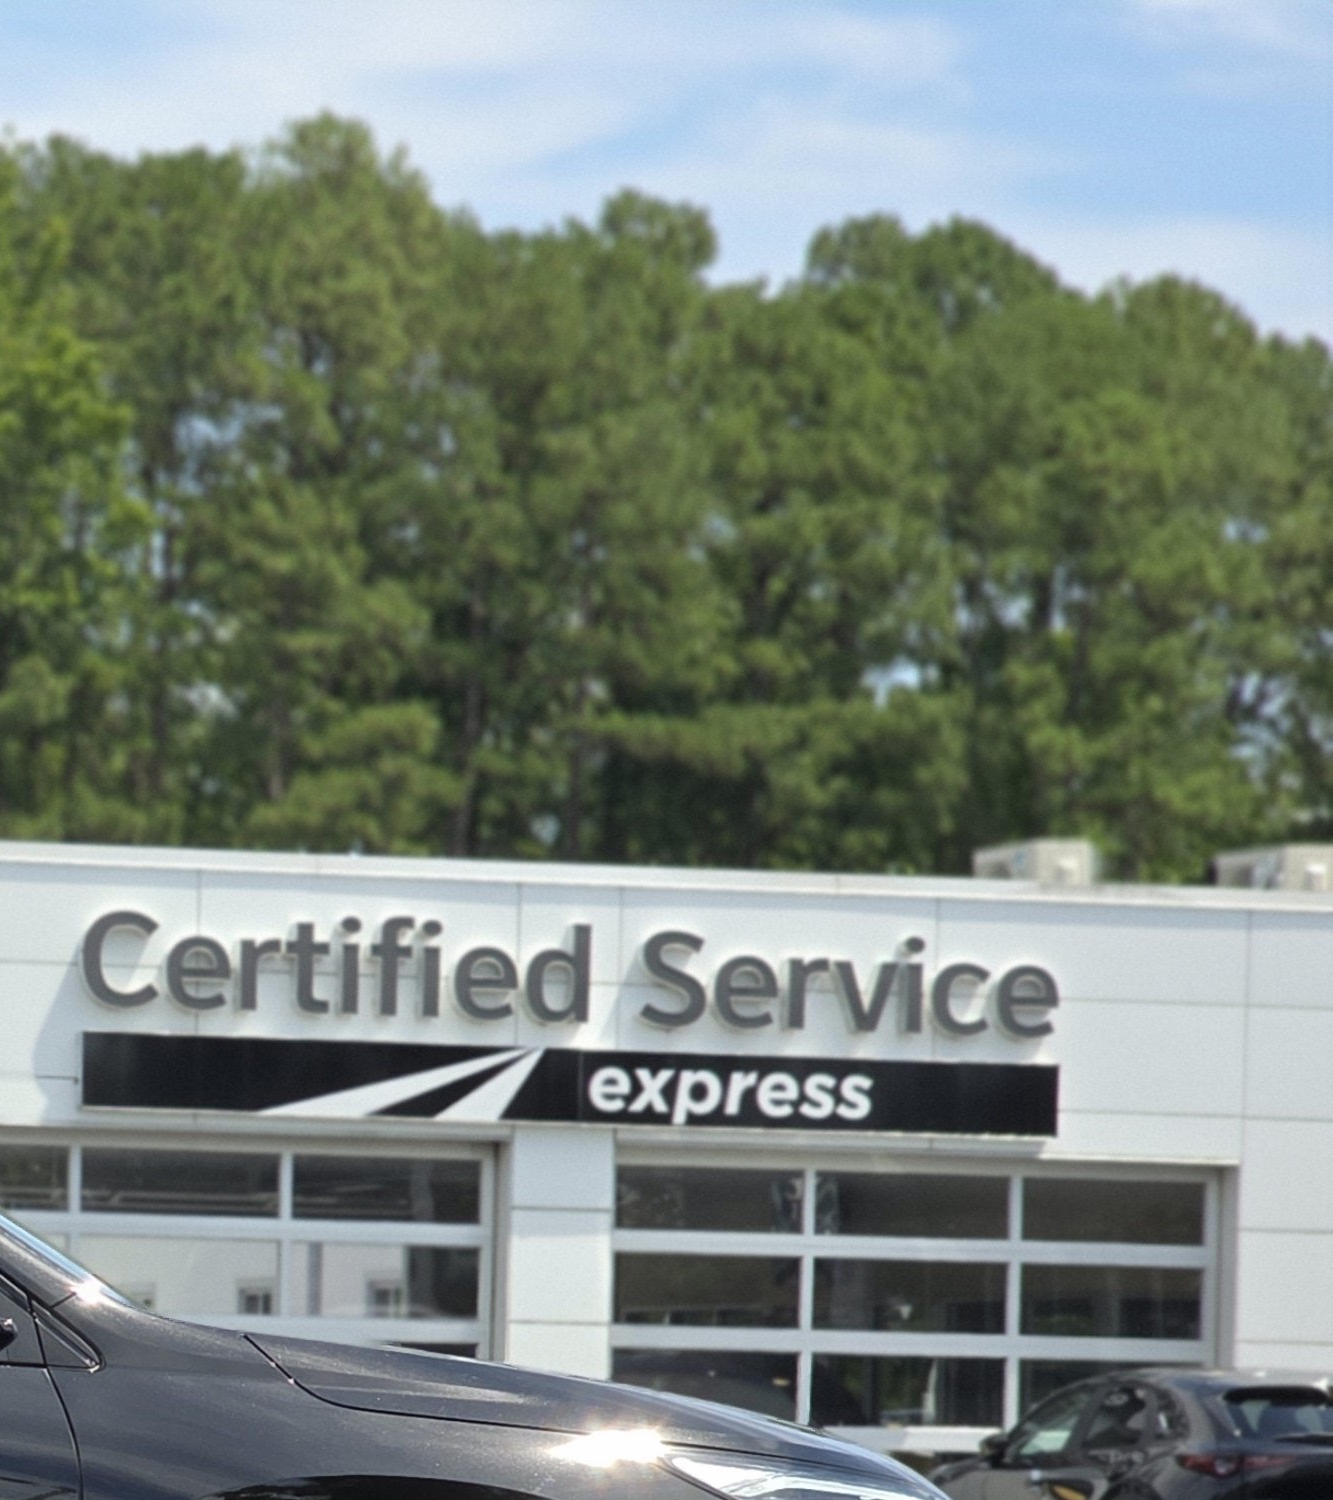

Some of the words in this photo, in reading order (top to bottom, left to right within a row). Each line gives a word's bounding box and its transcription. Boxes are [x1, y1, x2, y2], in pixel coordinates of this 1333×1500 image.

[81, 910, 592, 1023] Certified
[640, 930, 1061, 1038] Service
[588, 1068, 874, 1125] express
